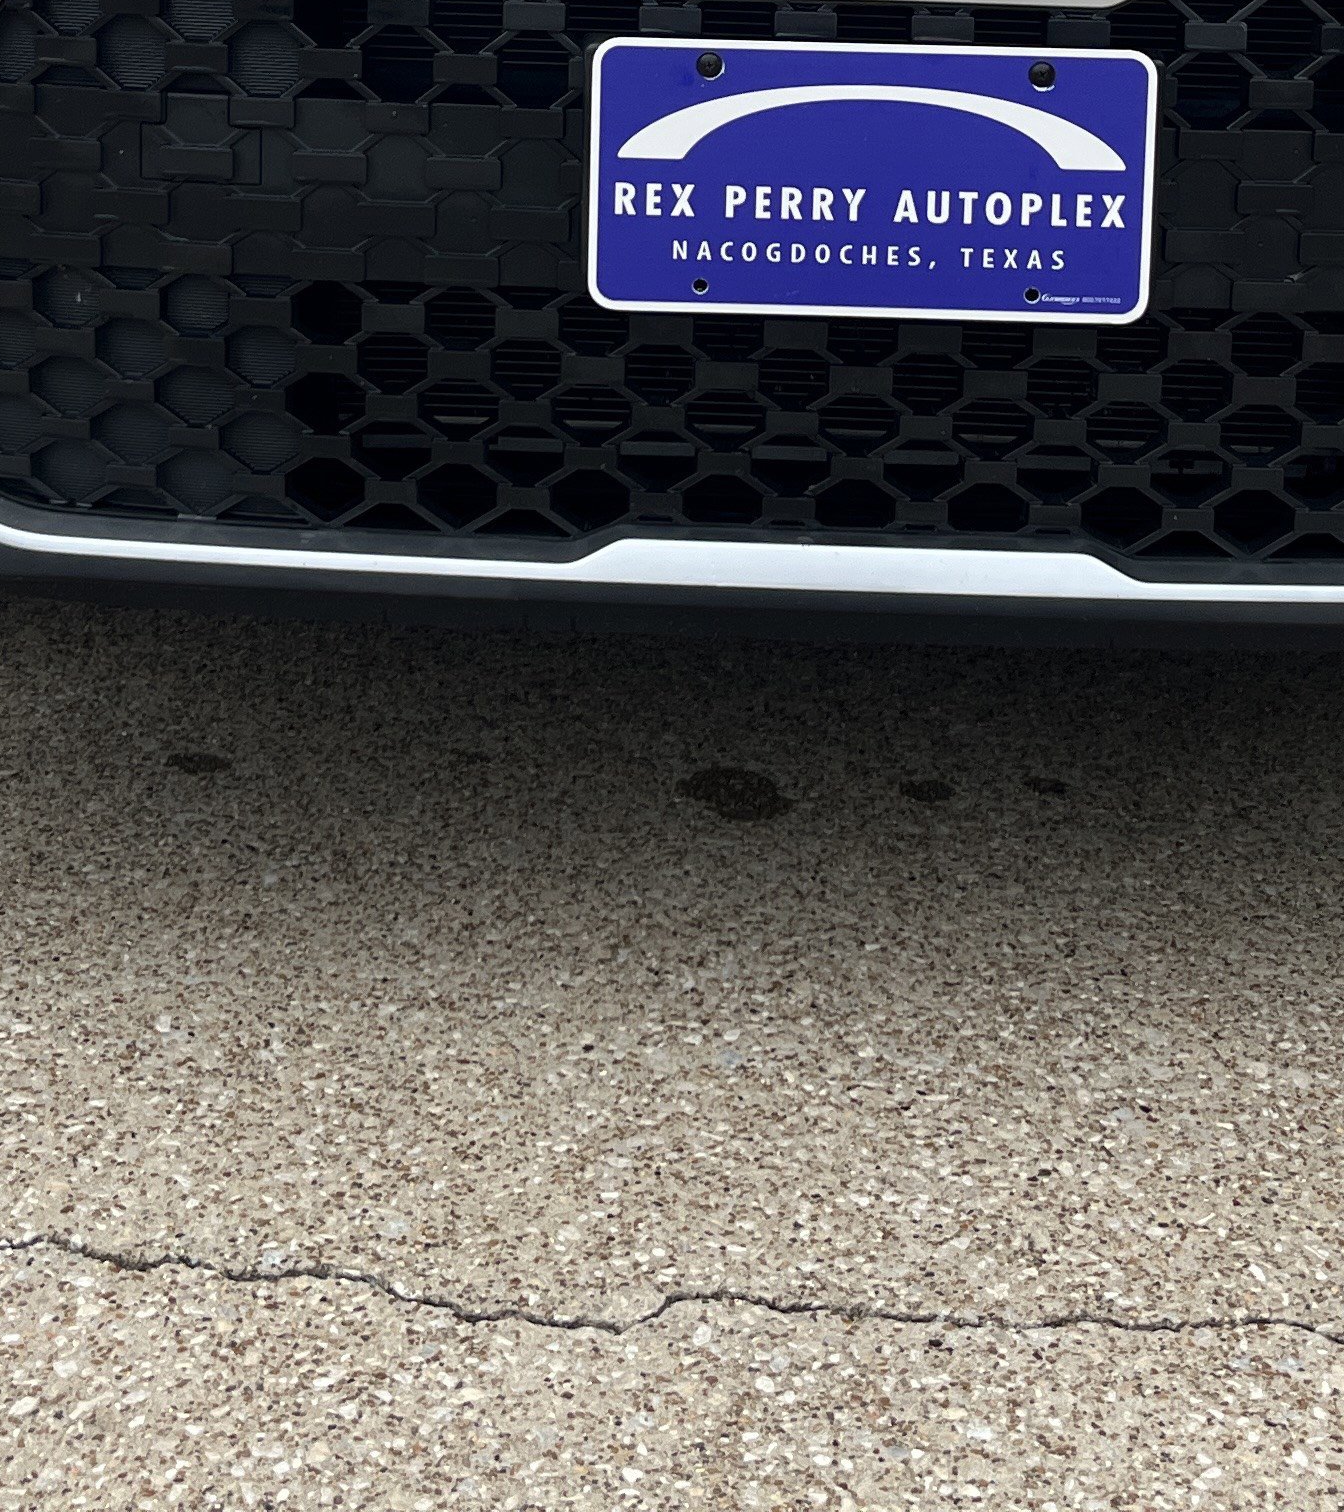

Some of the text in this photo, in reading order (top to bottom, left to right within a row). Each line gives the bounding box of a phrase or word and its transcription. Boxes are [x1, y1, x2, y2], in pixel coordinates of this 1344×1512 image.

[614, 181, 1127, 229] REX PERRY AUTOPLEX
[672, 239, 1066, 270] NACOGDOCHES, TEXAS
